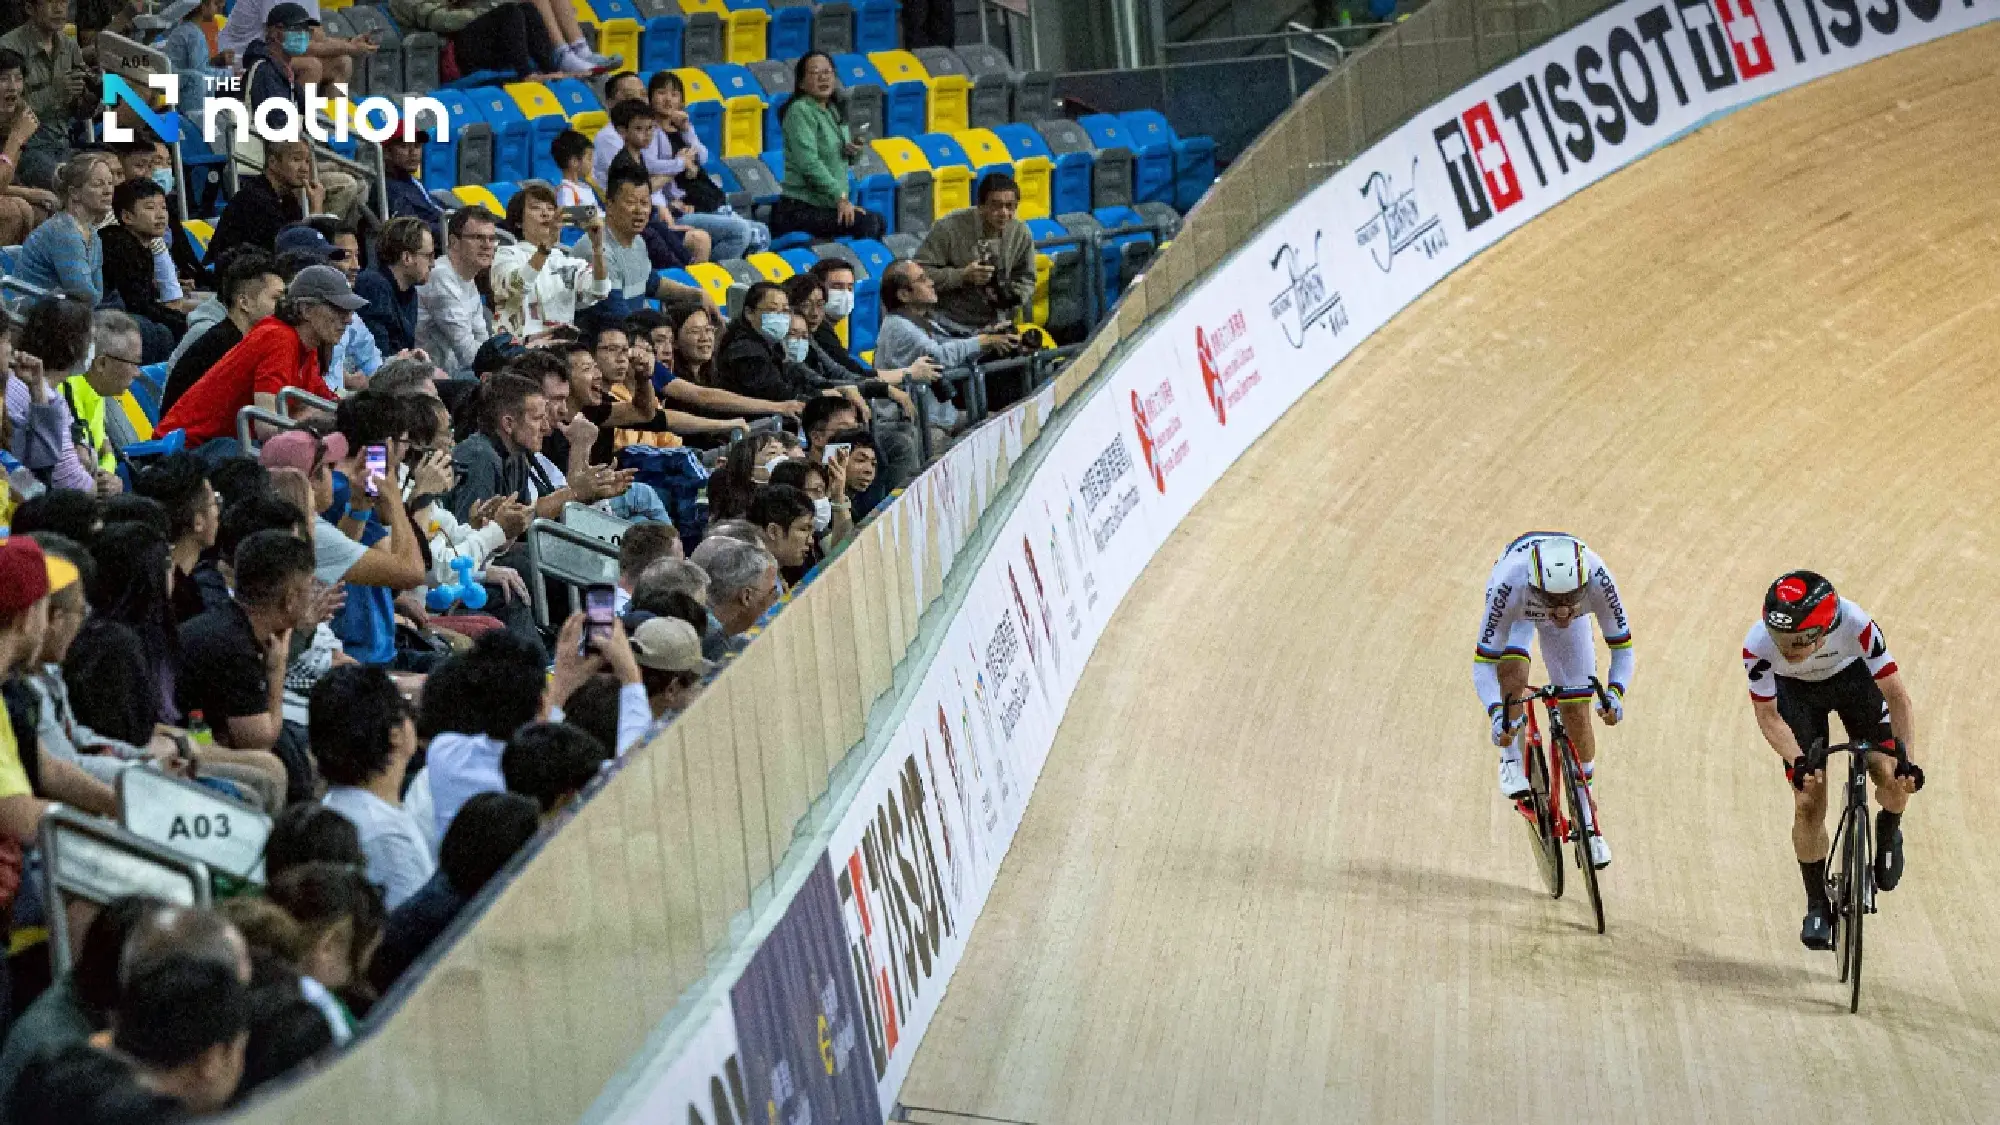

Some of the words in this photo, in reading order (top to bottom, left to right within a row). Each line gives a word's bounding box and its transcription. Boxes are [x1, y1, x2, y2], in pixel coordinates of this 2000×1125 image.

[1495, 5, 1690, 188] TISSOT
[1481, 582, 1512, 644] PORTUGAL
[1595, 566, 1627, 629] PORTUGAL
[168, 813, 232, 841] A03
[862, 753, 951, 1028] TISSOT
